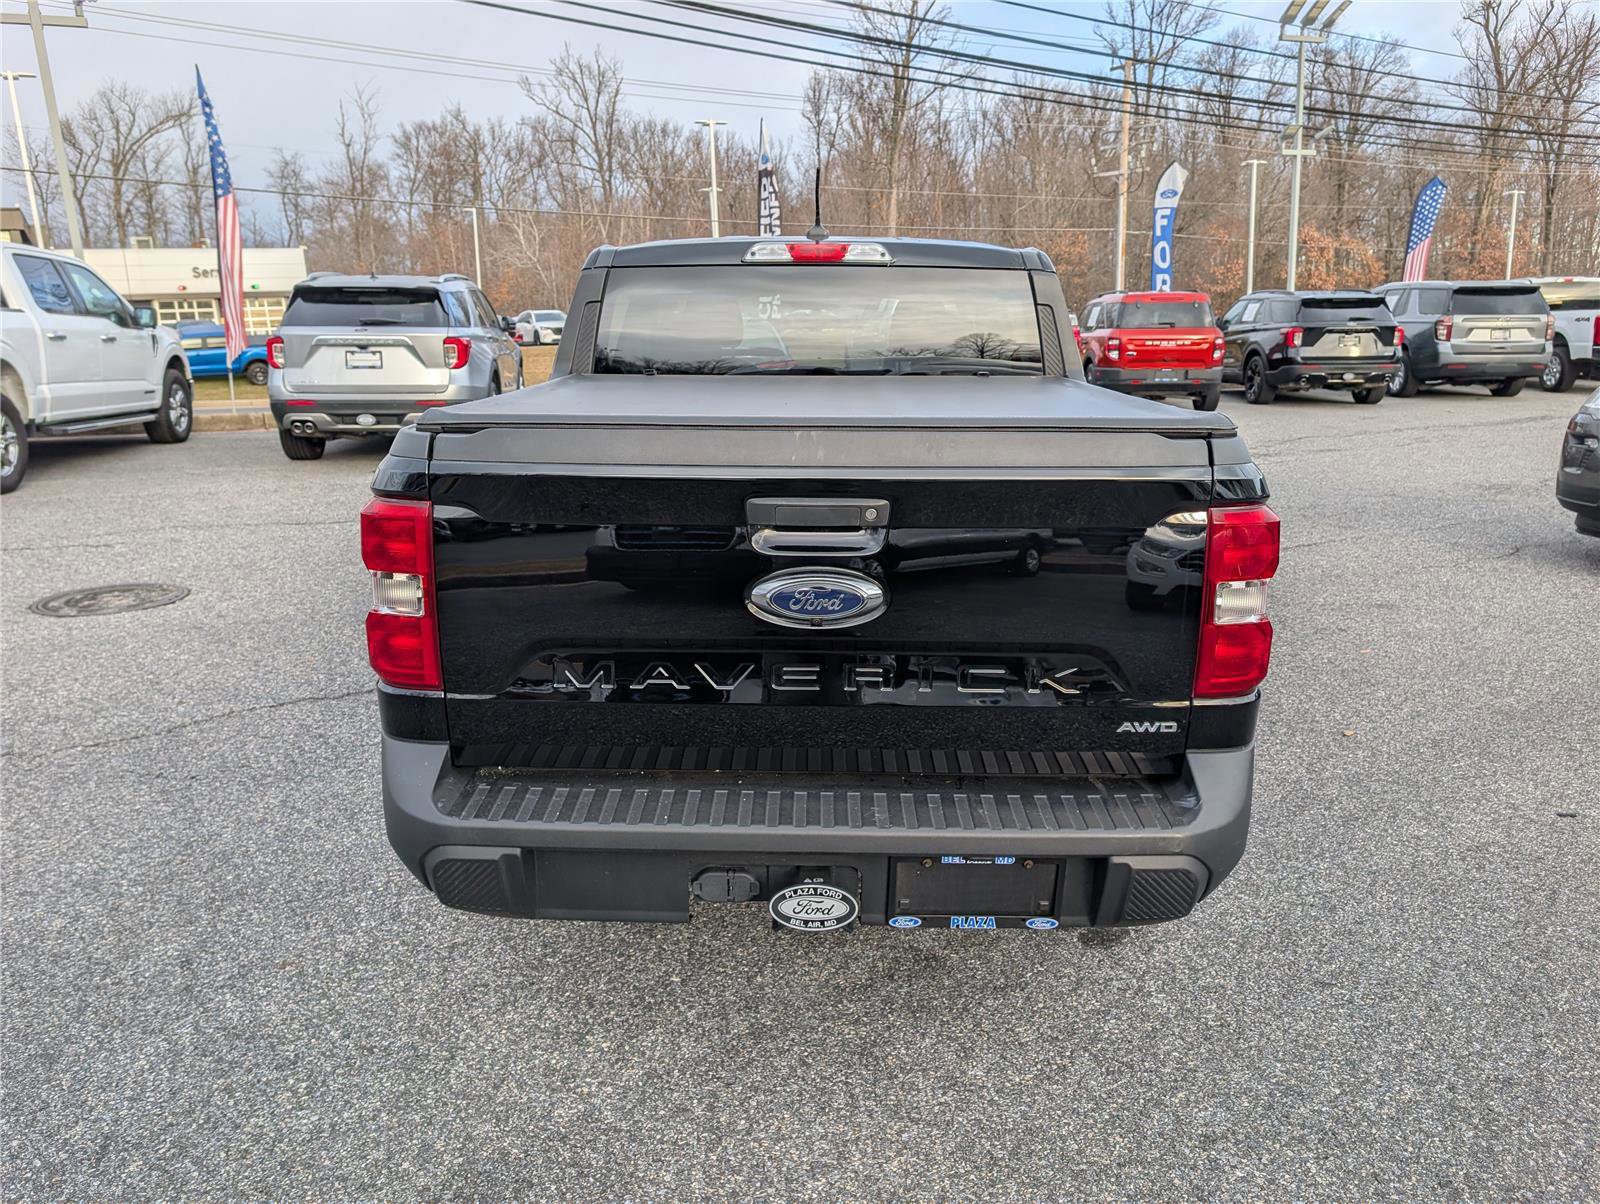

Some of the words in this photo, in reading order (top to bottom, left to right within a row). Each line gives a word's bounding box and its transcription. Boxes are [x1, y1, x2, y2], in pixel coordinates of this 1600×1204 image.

[1153, 208, 1172, 292] FOR
[192, 266, 219, 279] Ser
[788, 586, 845, 611] Ford
[551, 658, 1082, 694] MAVERICK
[1115, 721, 1178, 733] AWD
[784, 888, 815, 899] PLAZA
[817, 888, 843, 900] FORD
[792, 899, 835, 916] Ford
[789, 917, 806, 928] BEL
[824, 919, 837, 928] MD
[950, 915, 997, 929] PLAZA
